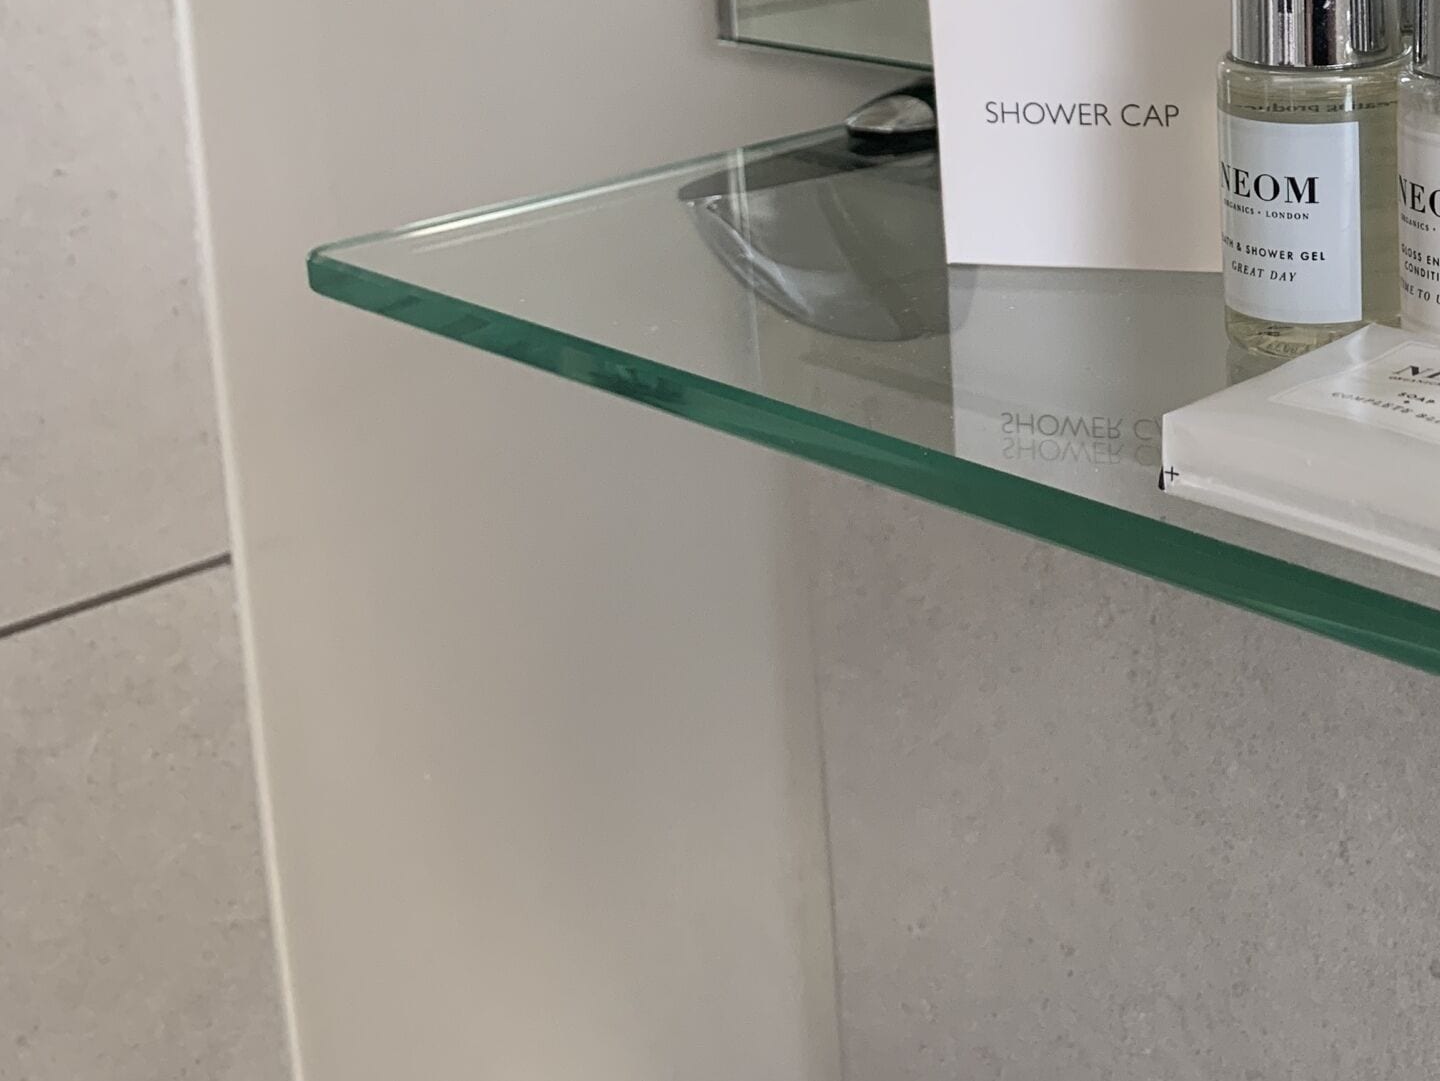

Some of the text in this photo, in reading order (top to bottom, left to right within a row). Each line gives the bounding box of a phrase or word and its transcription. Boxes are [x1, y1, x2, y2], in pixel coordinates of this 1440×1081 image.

[985, 100, 1181, 128] SHOWER CAP
[1220, 160, 1320, 204] NEOM
[1265, 210, 1310, 220] LONDON
[1245, 245, 1294, 261] SHOWER
[1300, 251, 1326, 261] GEL
[1231, 260, 1297, 282] GREAT DAY
[1417, 288, 1431, 301] TO
[1397, 391, 1436, 404] SOAP
